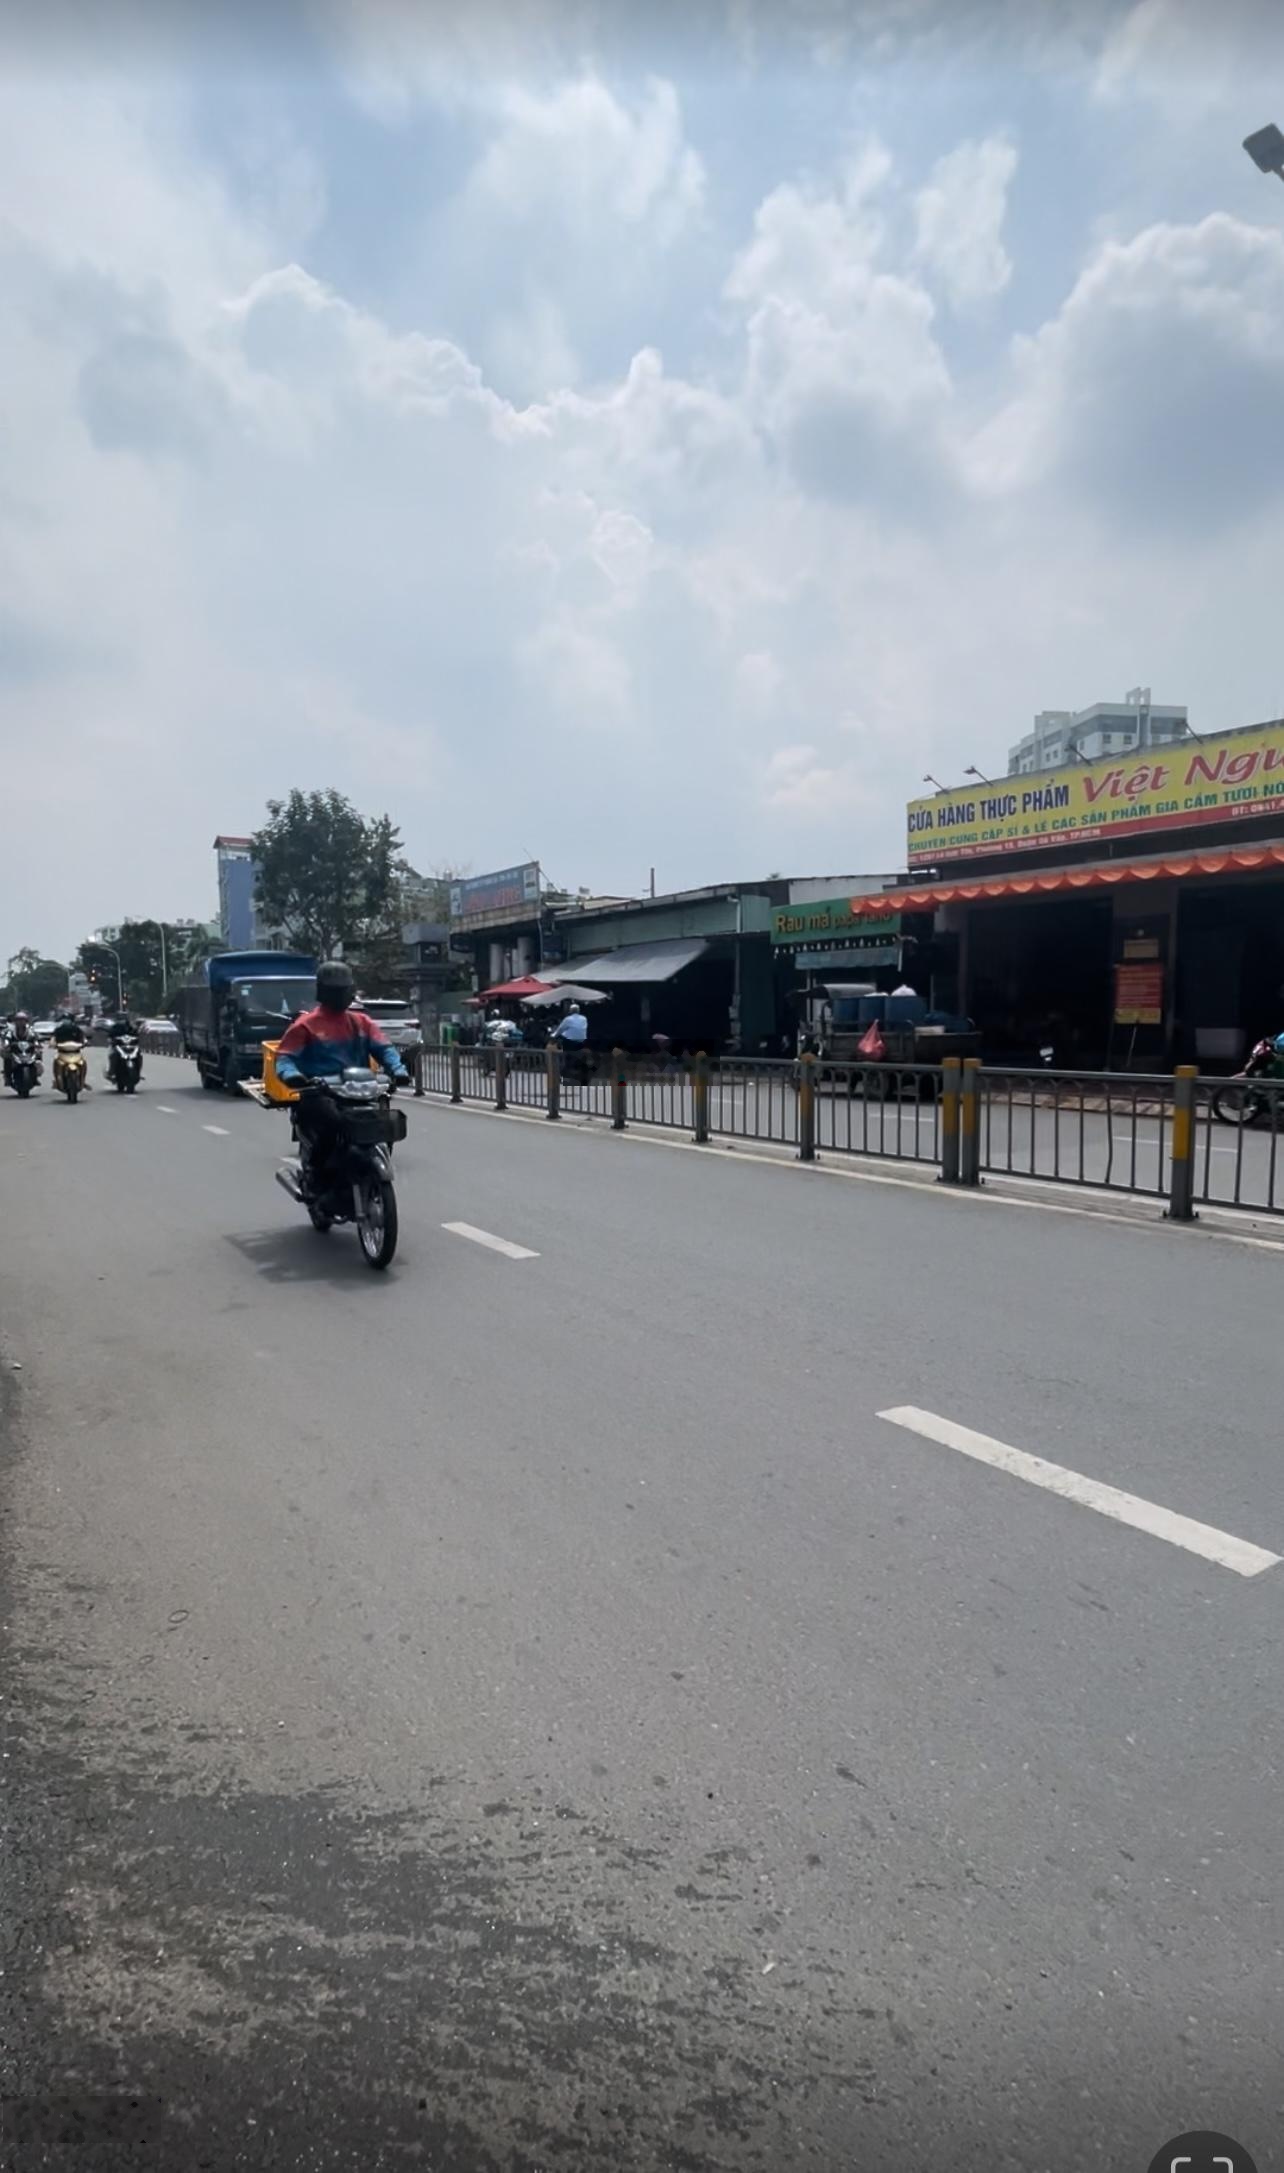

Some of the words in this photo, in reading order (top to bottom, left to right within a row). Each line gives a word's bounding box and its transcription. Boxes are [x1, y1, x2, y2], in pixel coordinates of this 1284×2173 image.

[908, 805, 933, 833] CỬA
[937, 803, 975, 828] HÀNG
[980, 795, 1016, 822] THỰC
[1023, 778, 1069, 813] PHẨM
[1083, 765, 1169, 802] Việt
[1052, 816, 1077, 830] CÁC
[1112, 803, 1151, 820] PHẨM
[1156, 800, 1178, 813] GIA
[776, 914, 804, 933] Rau
[810, 906, 830, 929] má
